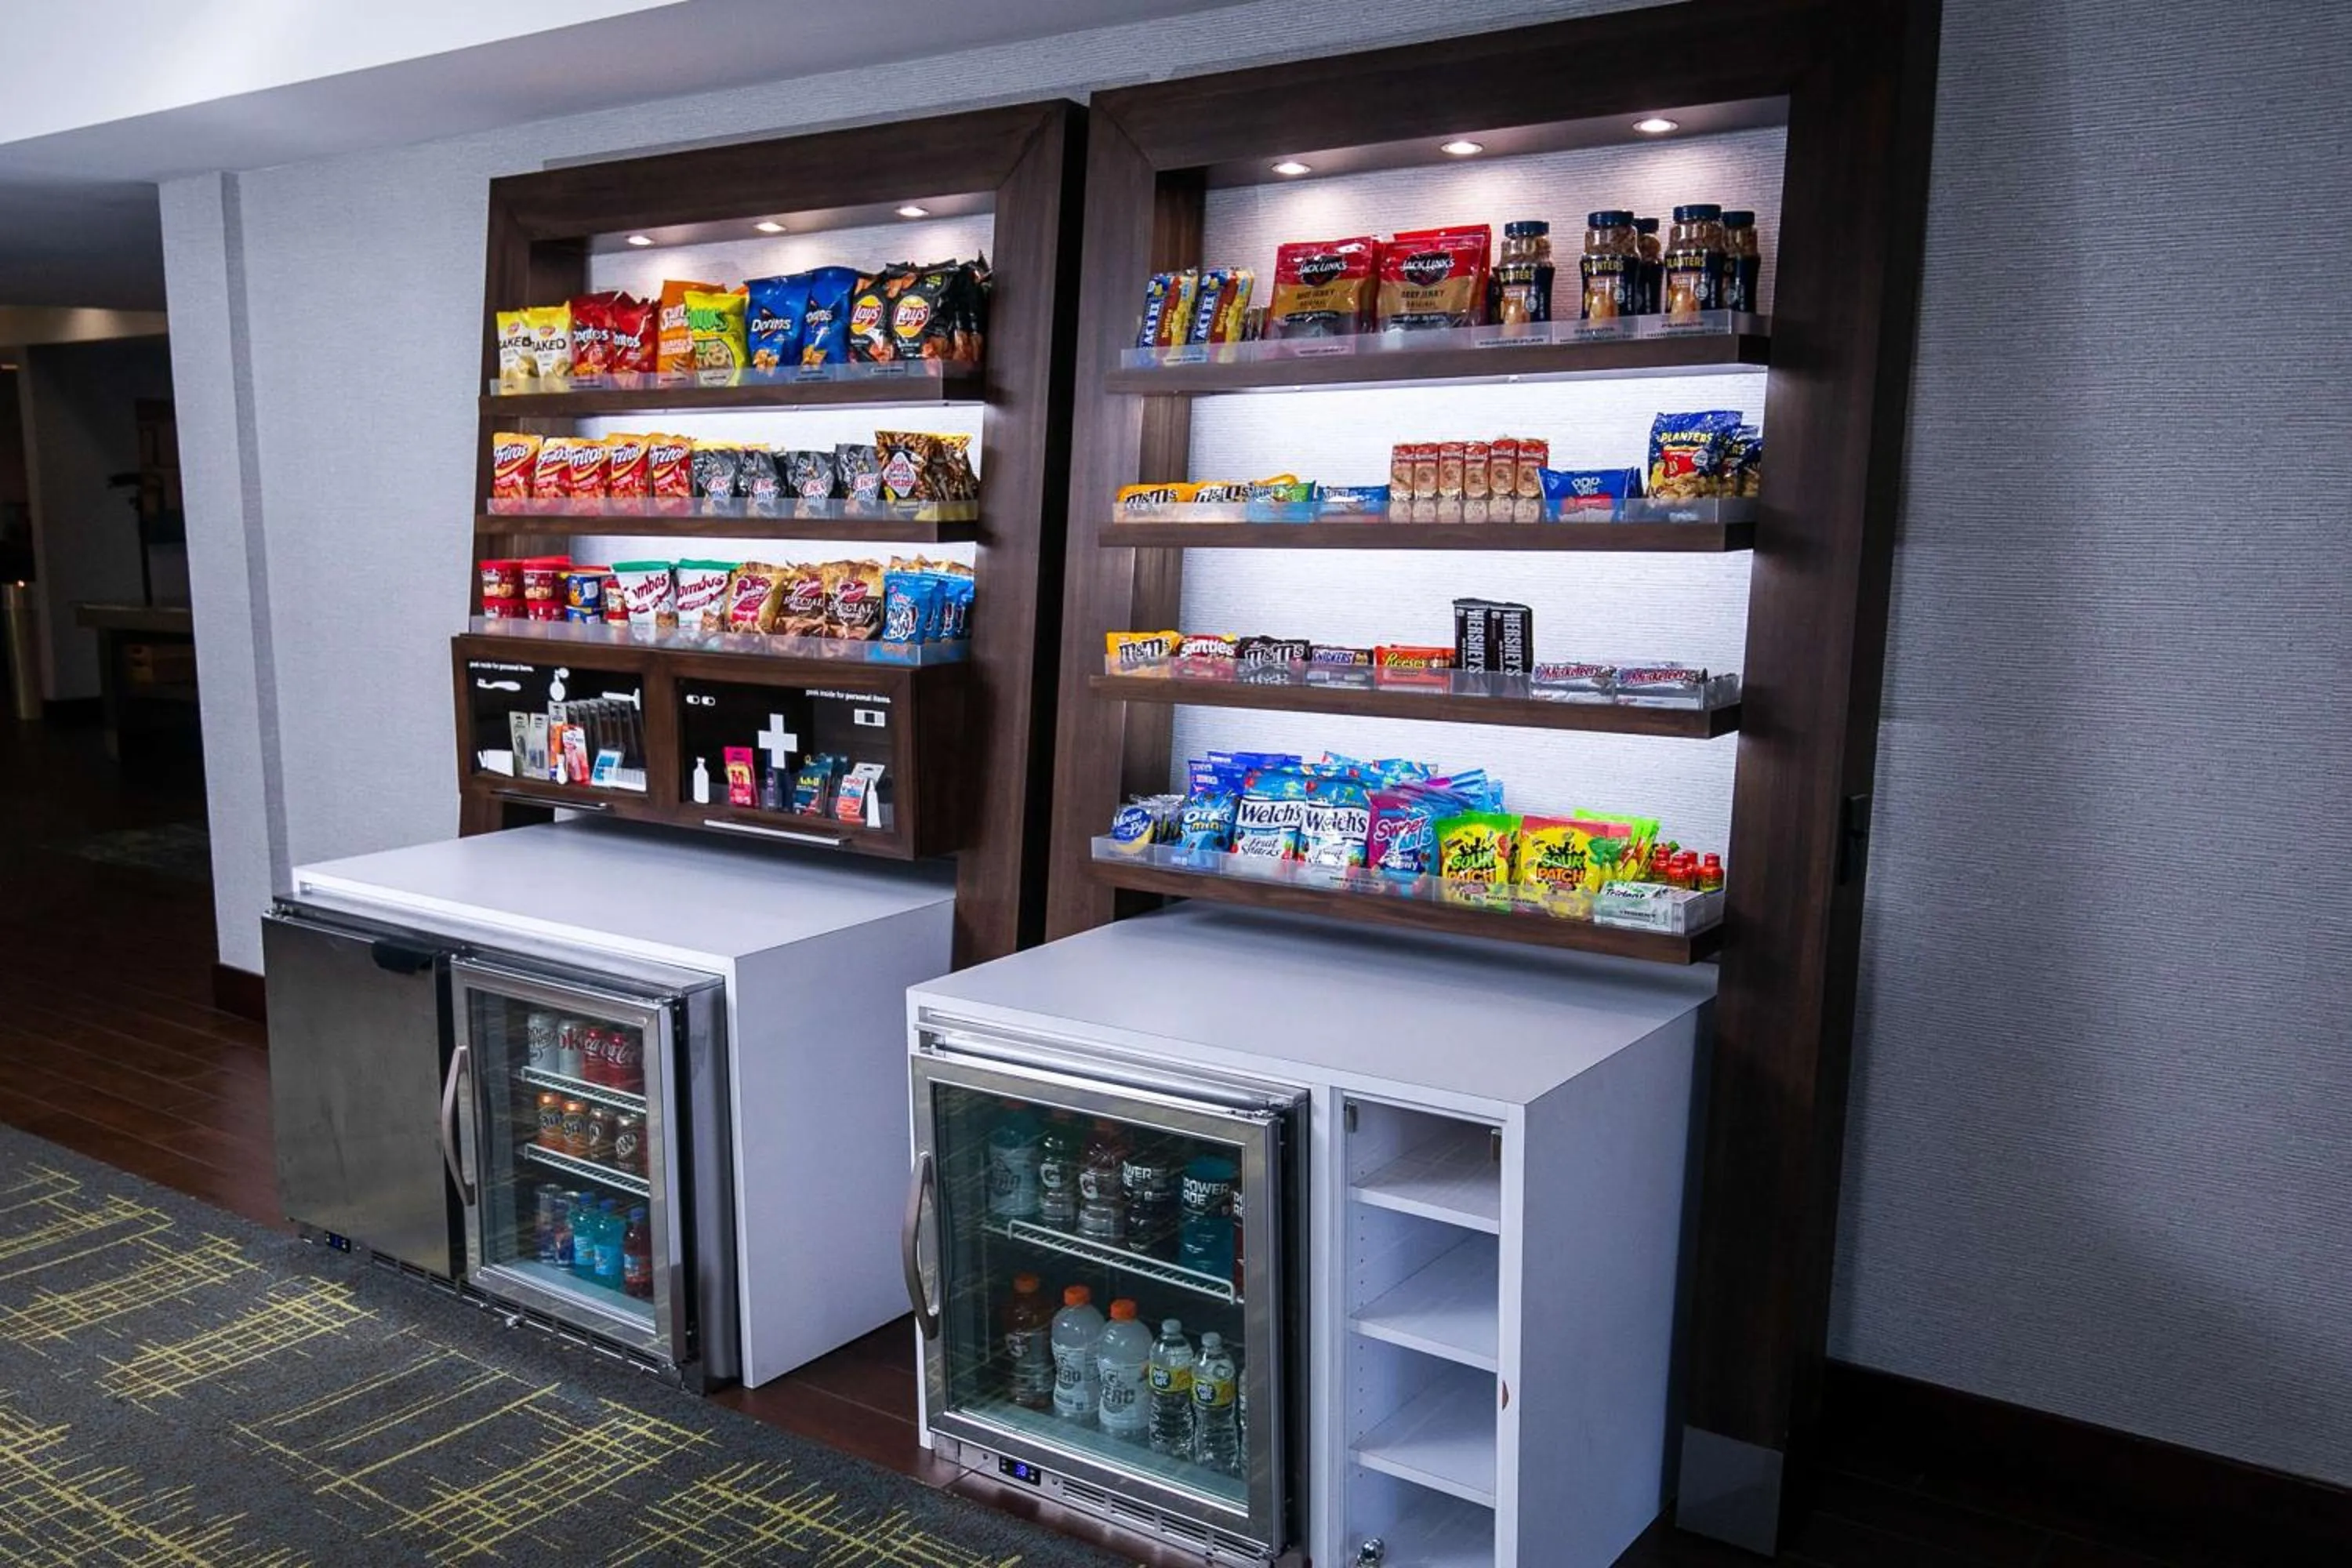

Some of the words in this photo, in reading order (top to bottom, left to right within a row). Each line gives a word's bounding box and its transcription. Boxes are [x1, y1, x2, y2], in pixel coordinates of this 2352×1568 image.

[751, 318, 792, 332] Doritos
[1657, 432, 1713, 443] PLANTERS
[784, 595, 823, 607] SPECIAL
[827, 601, 872, 613] SPECIAL
[1467, 608, 1486, 674] HERSHEY'S
[1503, 612, 1523, 677] HERSHEY'S
[1241, 800, 1303, 825] Welch's
[1305, 808, 1367, 834] Welch's
[1451, 851, 1494, 869] SOUR
[1541, 852, 1584, 868] SOUR
[1448, 868, 1495, 883] PATCH
[1537, 868, 1585, 883] PATCH
[1183, 1177, 1229, 1196] POWER
[1183, 1189, 1207, 1205] ADE
